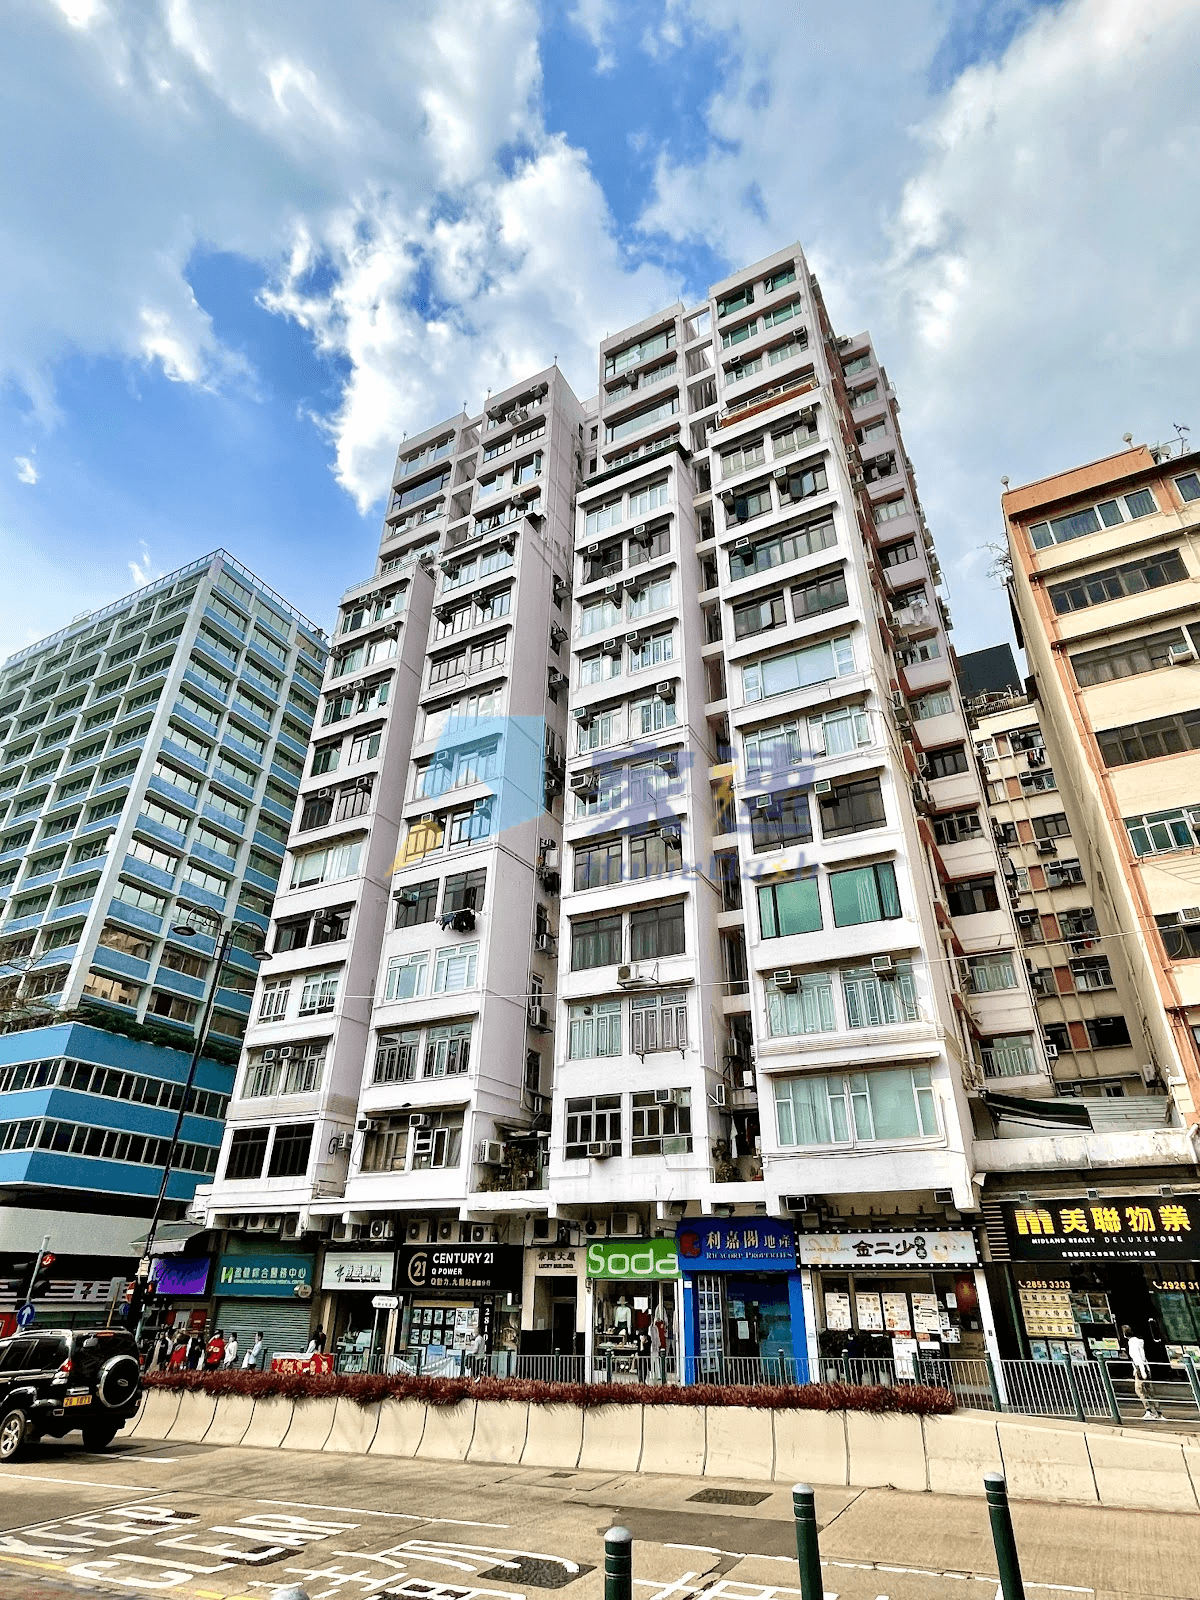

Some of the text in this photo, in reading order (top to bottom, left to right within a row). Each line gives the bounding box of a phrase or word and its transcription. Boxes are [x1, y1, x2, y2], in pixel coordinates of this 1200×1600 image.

[1059, 1205, 1191, 1233] 美聯物業
[706, 1229, 791, 1249] 利嘉閣地產
[852, 1239, 915, 1257] 金二少
[433, 1252, 494, 1264] CENTURY 21
[588, 1243, 679, 1274] Soda
[431, 1267, 463, 1276] Q POWER
[1026, 1280, 1071, 1289] 2855 3333
[1162, 1280, 1186, 1290] 2926
[0, 1505, 200, 1560] KEEP
[66, 1514, 362, 1589] CLEAR
